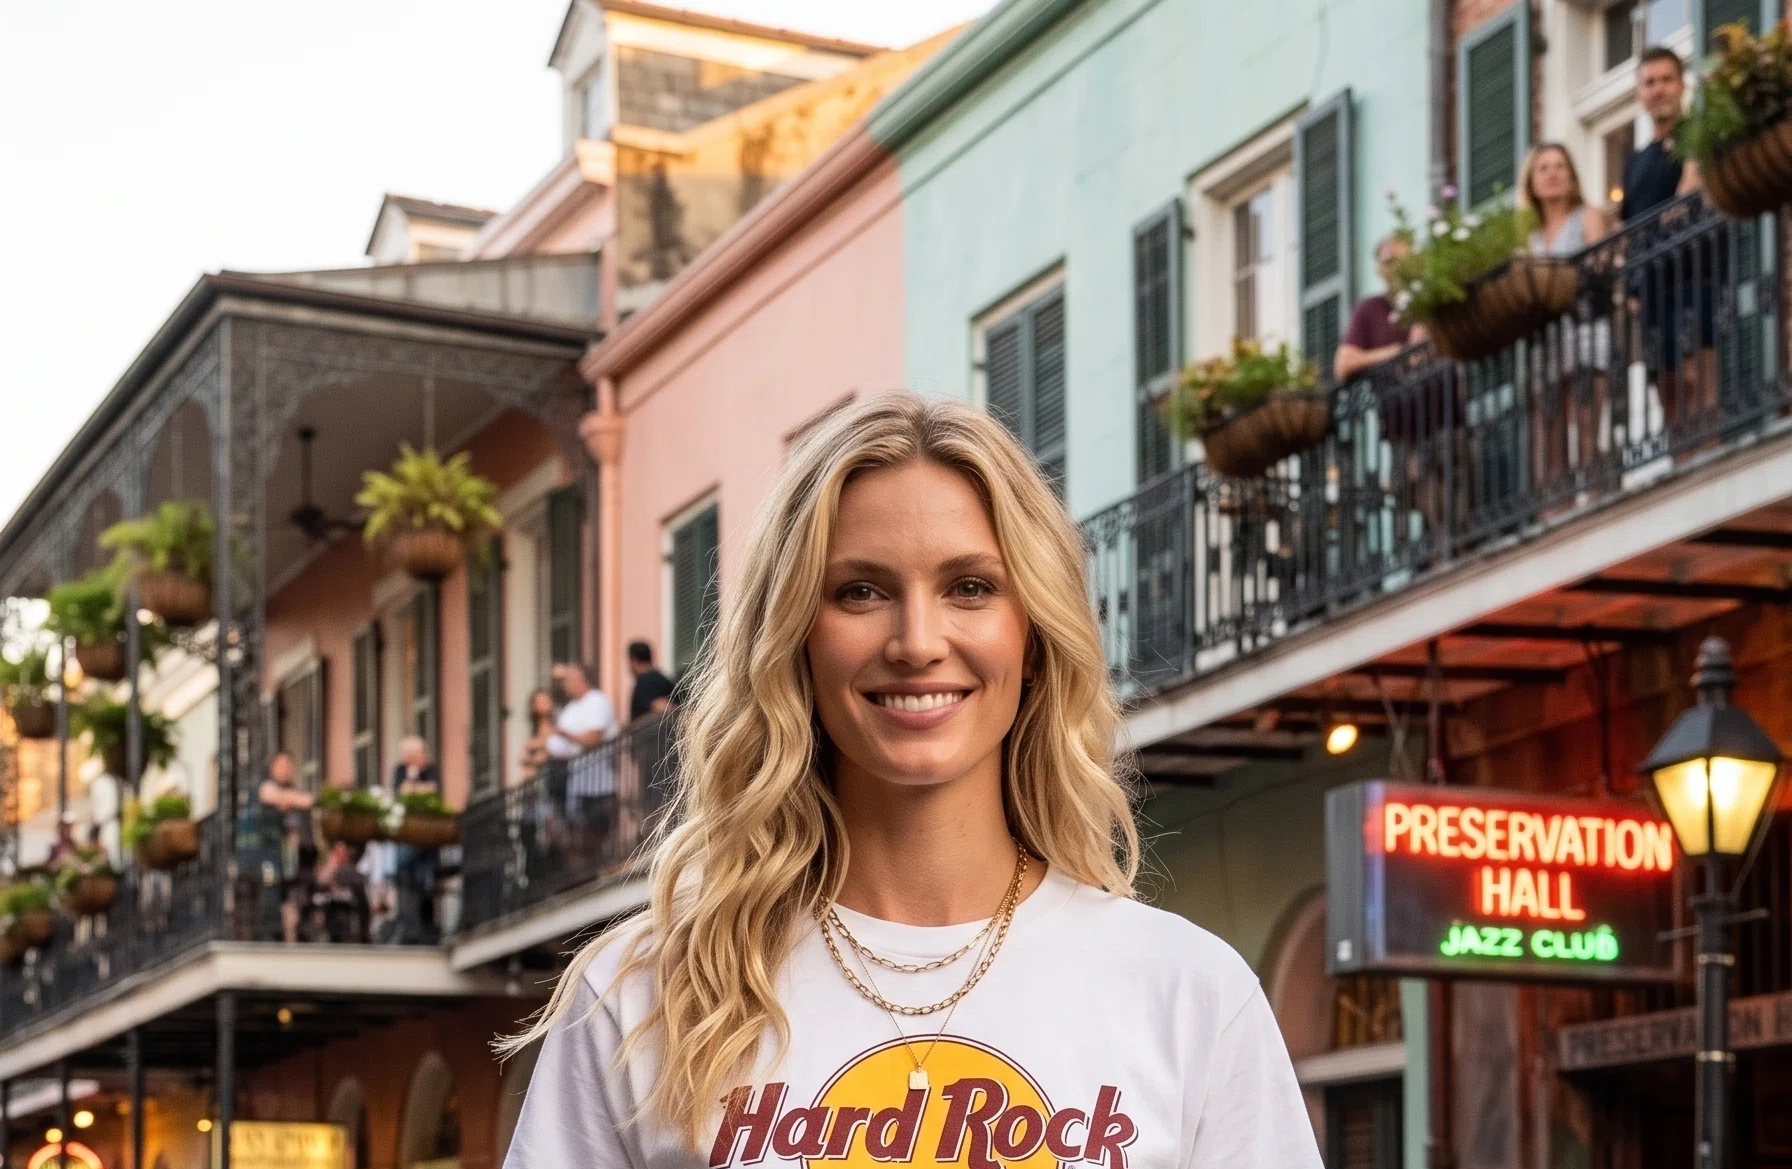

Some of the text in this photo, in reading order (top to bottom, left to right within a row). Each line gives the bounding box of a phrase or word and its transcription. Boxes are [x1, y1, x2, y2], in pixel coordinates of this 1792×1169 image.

[1383, 802, 1674, 872] PRESERVATION
[1480, 866, 1586, 921] HALL
[1439, 924, 1524, 957] JAZZ
